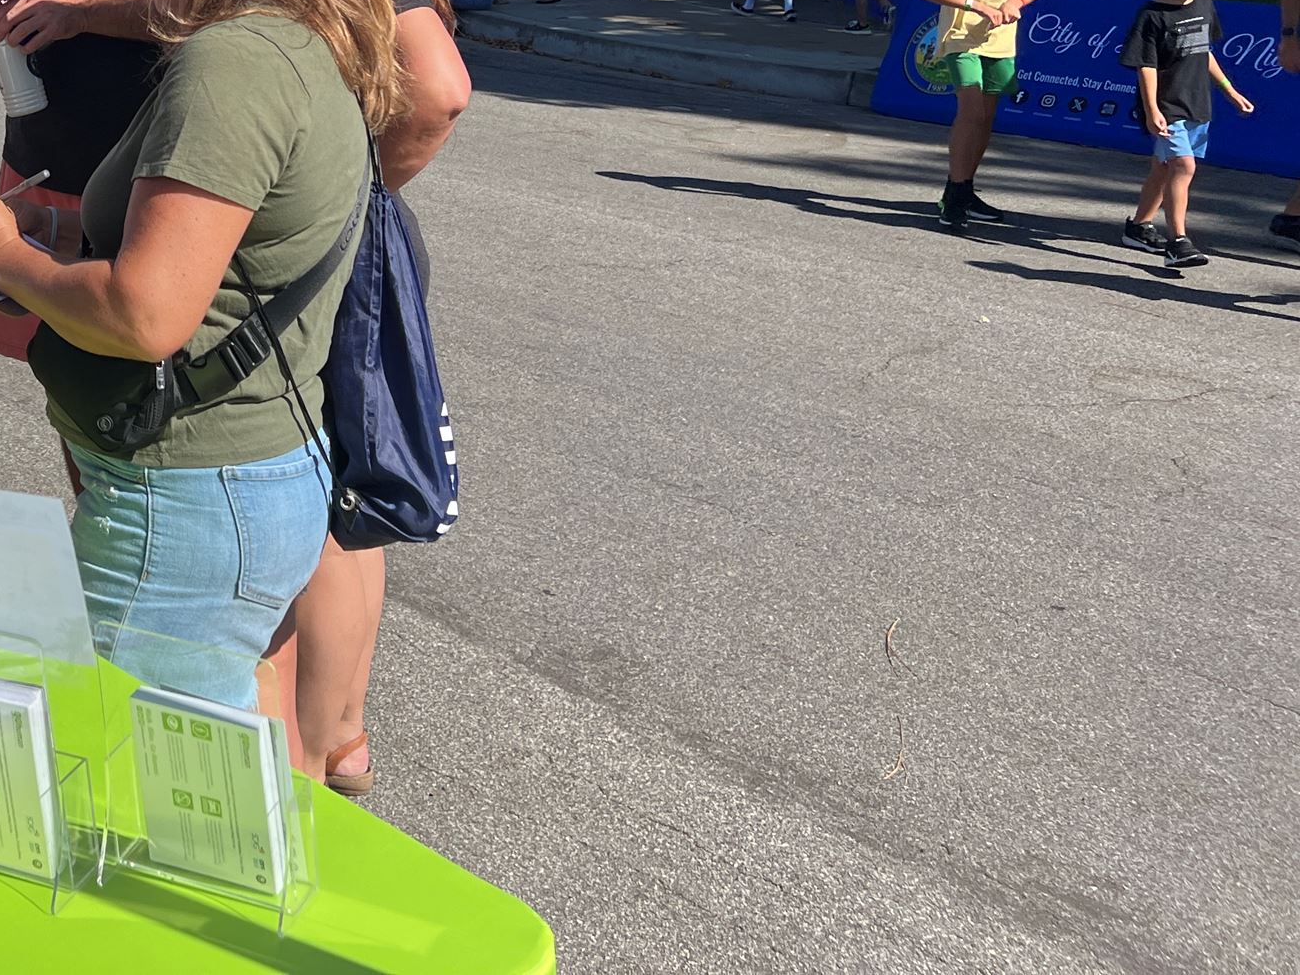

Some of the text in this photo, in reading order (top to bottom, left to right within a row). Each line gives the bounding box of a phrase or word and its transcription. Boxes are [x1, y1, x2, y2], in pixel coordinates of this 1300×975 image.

[1028, 12, 1082, 54] City
[1088, 25, 1117, 59] of
[926, 83, 947, 92] 1989
[1017, 68, 1033, 81] Get
[1034, 71, 1080, 88] Connected,
[1082, 76, 1103, 92] Stay
